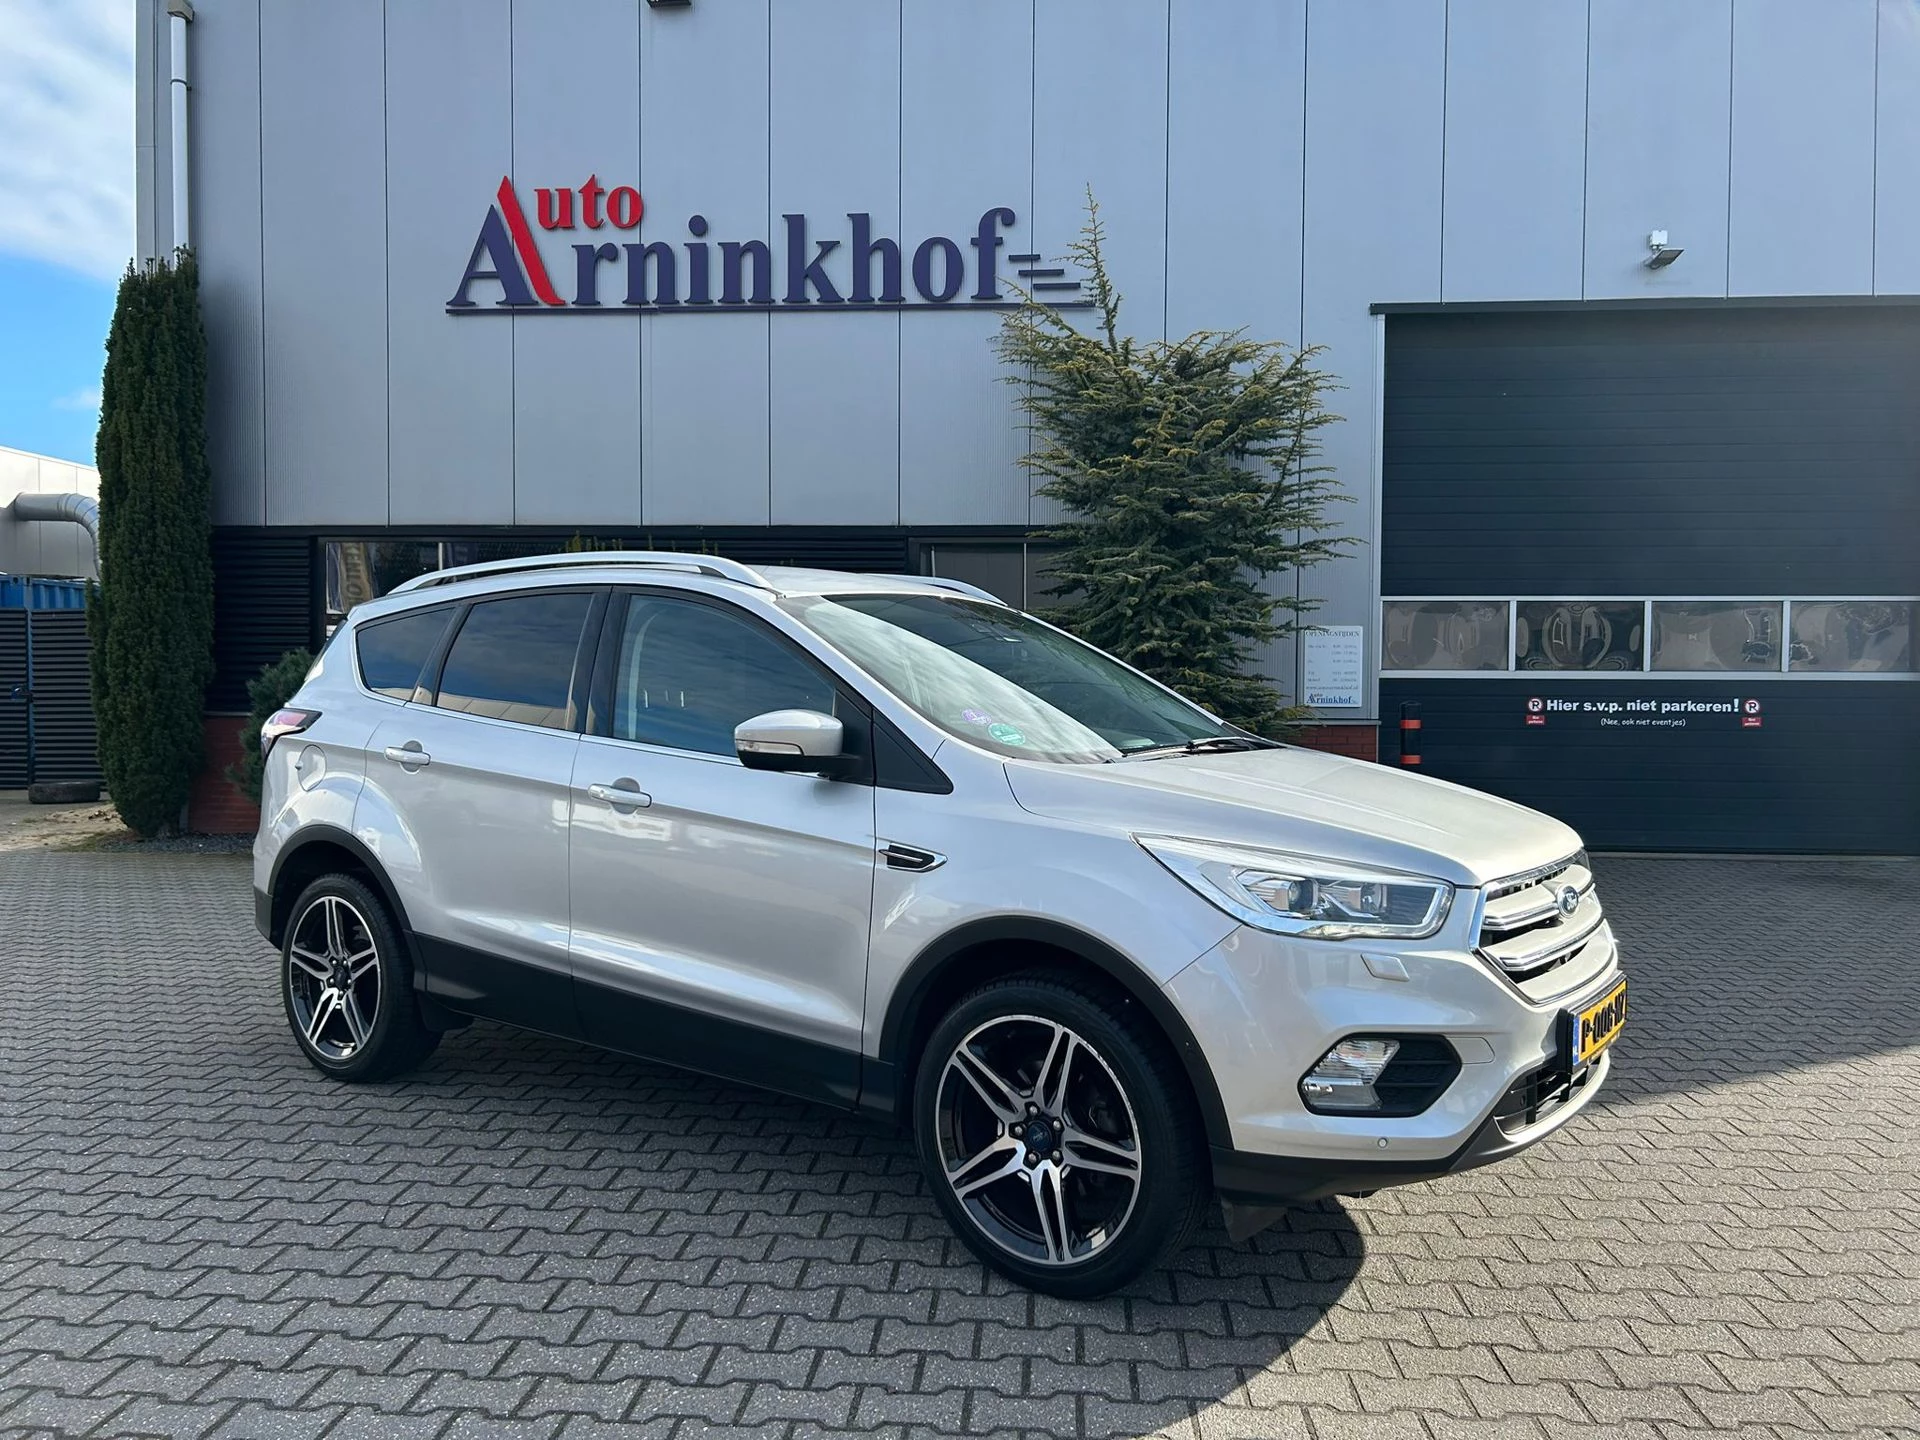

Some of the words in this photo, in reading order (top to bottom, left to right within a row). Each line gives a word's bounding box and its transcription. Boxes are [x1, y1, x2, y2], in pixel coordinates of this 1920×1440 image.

[447, 203, 1015, 306] Arninkhof
[1546, 699, 1580, 711] Hier
[1583, 702, 1623, 713] s.v.p.
[1626, 699, 1657, 711] niet
[1661, 698, 1739, 714] parkeren!
[1600, 717, 1621, 726] (Nee,
[1621, 718, 1635, 726] ook
[1635, 718, 1650, 726] niet
[1651, 718, 1686, 727] eventjes)
